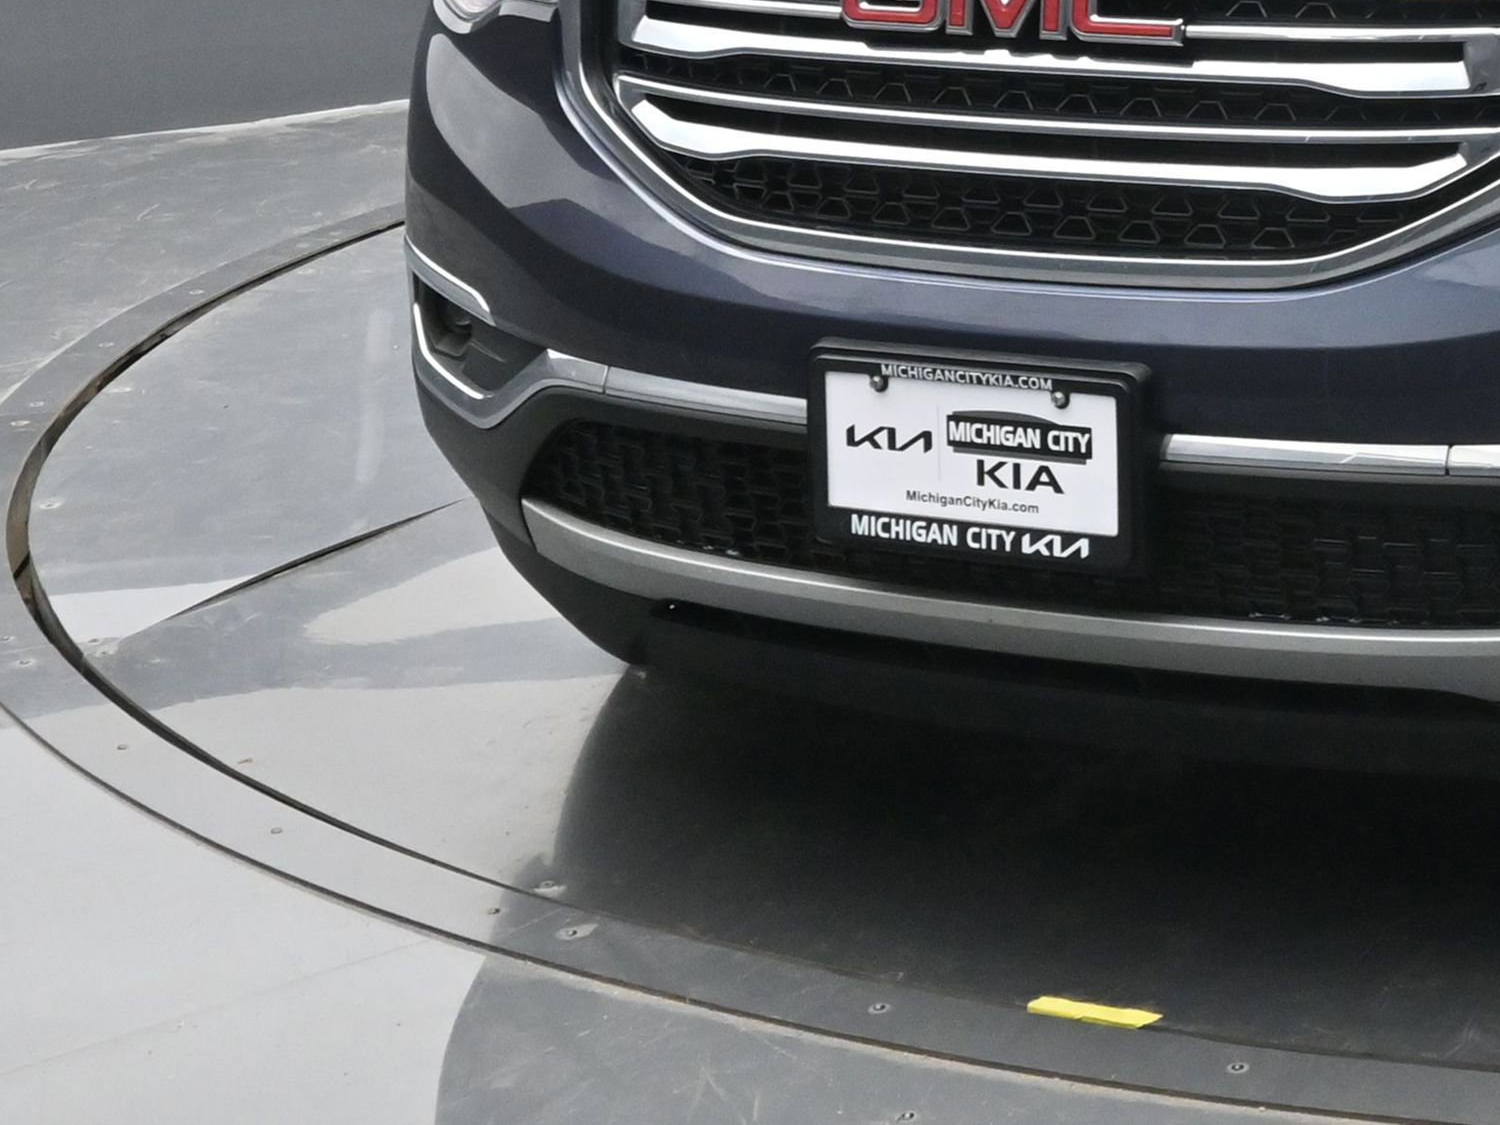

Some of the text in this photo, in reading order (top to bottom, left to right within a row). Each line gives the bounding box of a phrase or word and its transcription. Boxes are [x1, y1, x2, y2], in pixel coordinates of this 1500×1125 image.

[881, 363, 1053, 391] MICHIGANCITYKIA.COM
[948, 420, 1090, 453] MICHIGAN CITY
[976, 459, 1064, 494] KIA
[906, 490, 1039, 514] MichiganCityKia.com
[851, 514, 958, 546] MICHIGAN
[966, 527, 1016, 552] CITY
